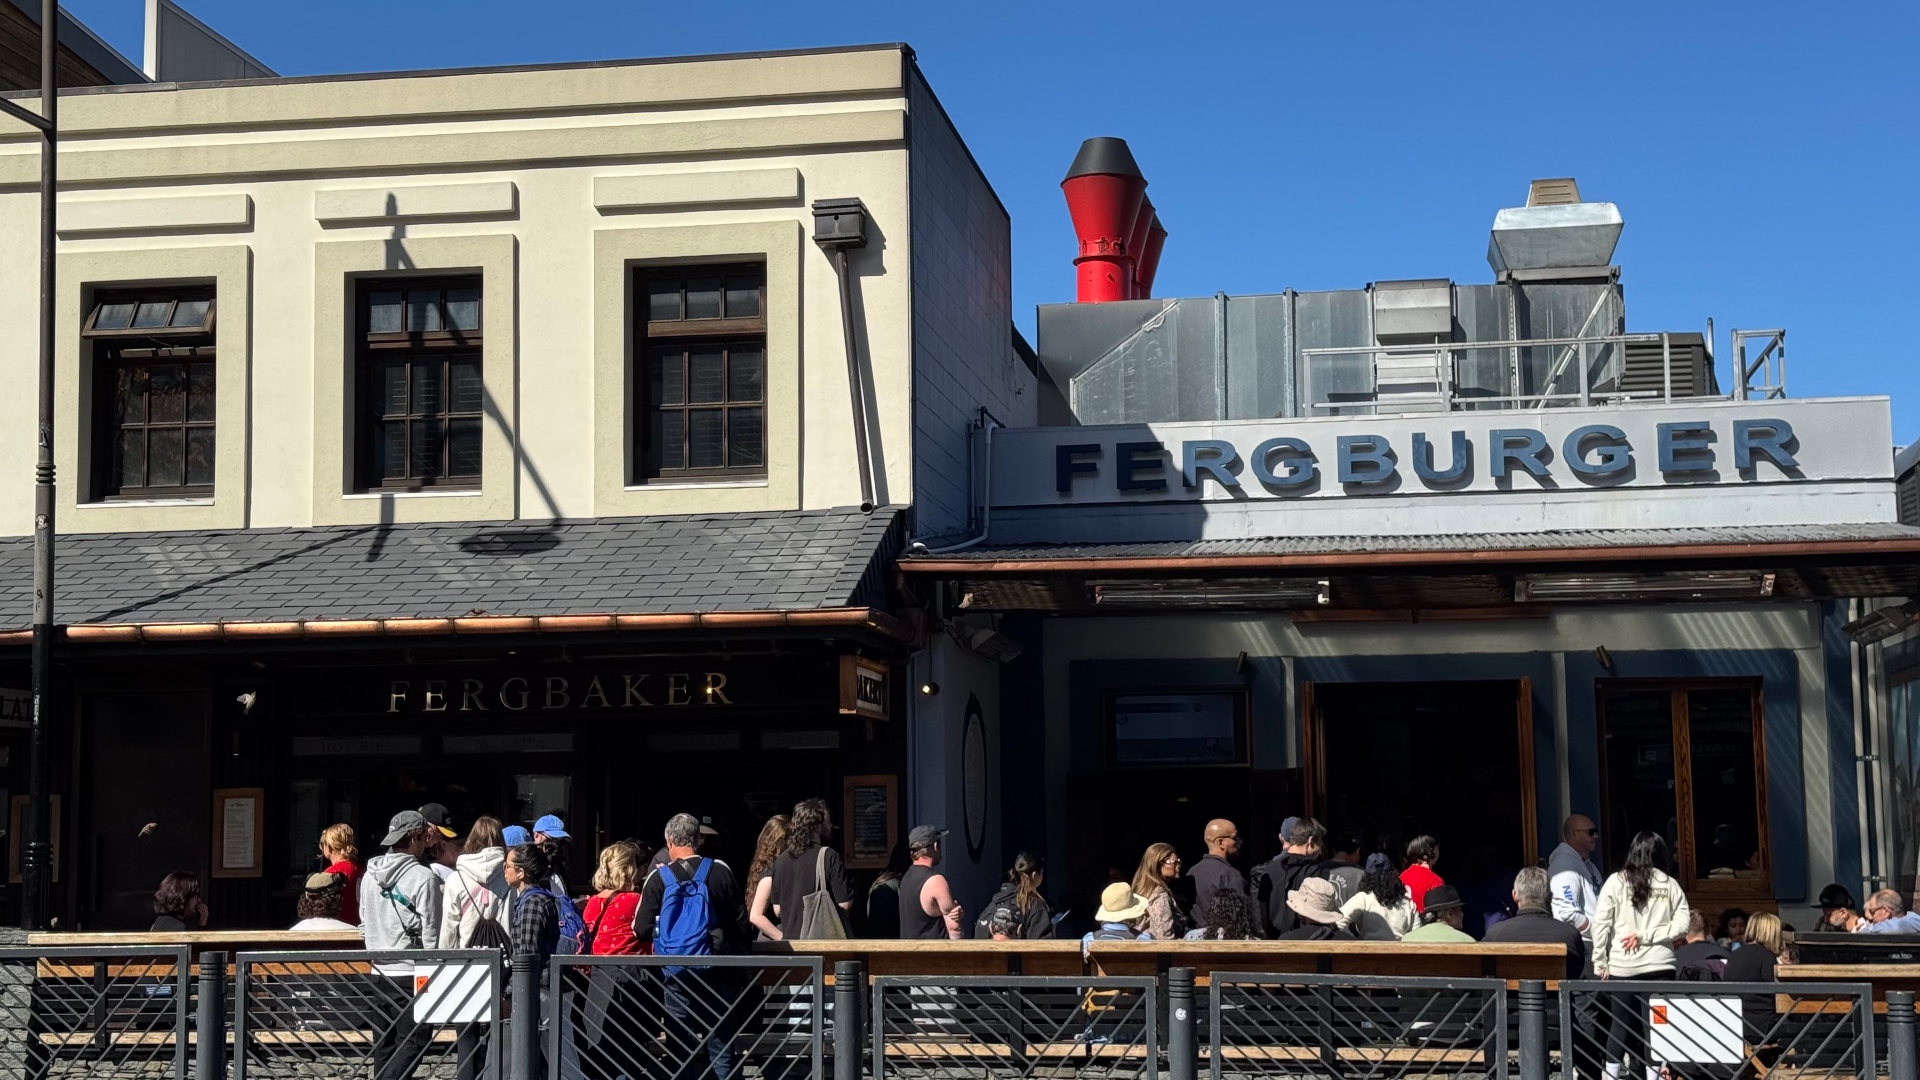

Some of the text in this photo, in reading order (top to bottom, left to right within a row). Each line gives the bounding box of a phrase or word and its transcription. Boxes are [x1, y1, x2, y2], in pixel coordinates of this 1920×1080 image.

[1056, 417, 1799, 493] FERGBURGER
[387, 671, 734, 714] FERGBAKER
[857, 674, 882, 705] AKERY
